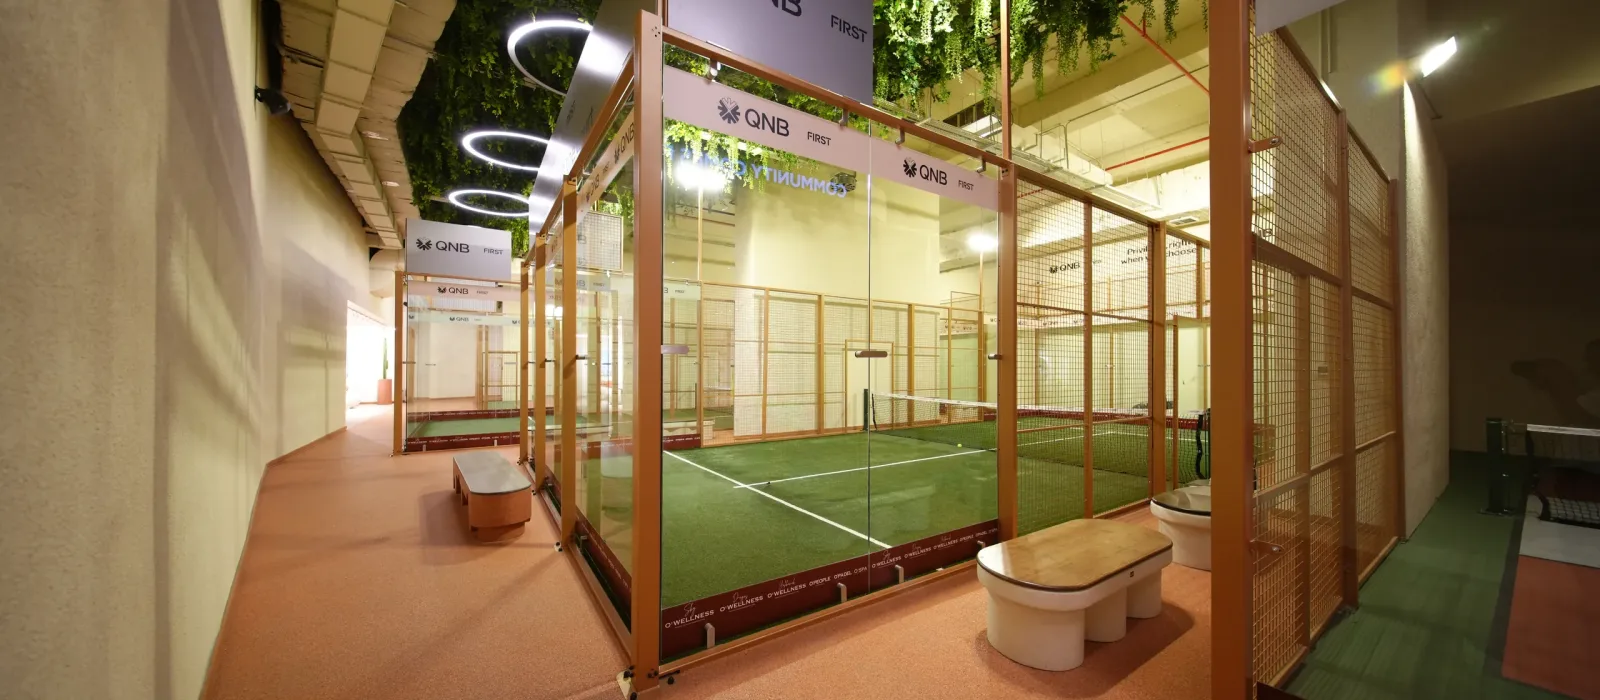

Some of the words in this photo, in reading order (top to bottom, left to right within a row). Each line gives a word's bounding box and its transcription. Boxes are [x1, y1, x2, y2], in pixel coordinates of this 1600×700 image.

[831, 14, 867, 43] FIRST
[621, 122, 634, 153] QNB
[745, 108, 790, 137] QNB
[807, 131, 831, 146] FIRST
[920, 164, 948, 186] QNB
[957, 180, 974, 191] FIRST
[436, 240, 470, 254] QNB
[1121, 256, 1144, 264] when
[1060, 262, 1080, 272] QNB
[448, 287, 469, 295] QNB
[665, 609, 714, 628] O'WELLNESS
[720, 595, 763, 612] O'WELLNESS
[767, 583, 807, 599] O'WELLNESS
